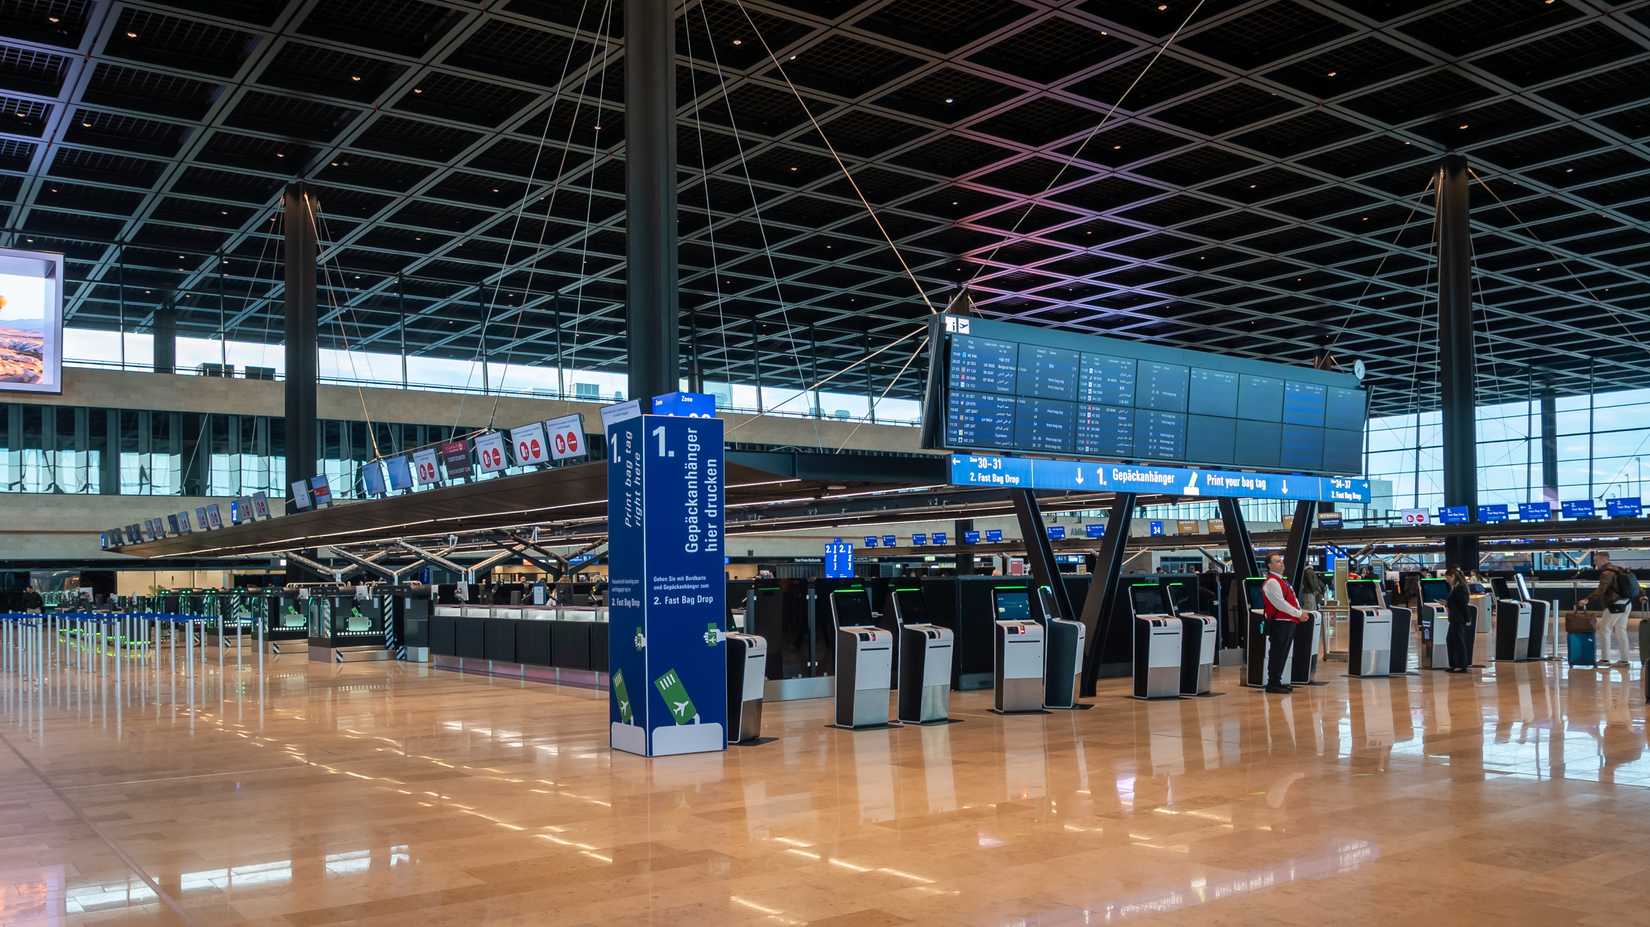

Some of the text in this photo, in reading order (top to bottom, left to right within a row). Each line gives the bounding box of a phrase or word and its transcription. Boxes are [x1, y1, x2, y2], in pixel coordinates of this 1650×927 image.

[681, 395, 693, 403] Zone
[610, 432, 622, 464] 1.
[651, 425, 676, 458] 1.
[624, 431, 633, 528] Print bag tag
[970, 472, 1020, 486] 2. Fast Bag Drop
[1096, 467, 1108, 486] 1.
[1112, 468, 1176, 485] Gepäckanhänger
[1206, 474, 1267, 491] Print your bag tag
[633, 452, 643, 528] right here
[684, 427, 701, 554] Gepäckanhänger
[703, 458, 718, 553] hier drucken
[653, 595, 714, 606] 2. Fast Bag Drop
